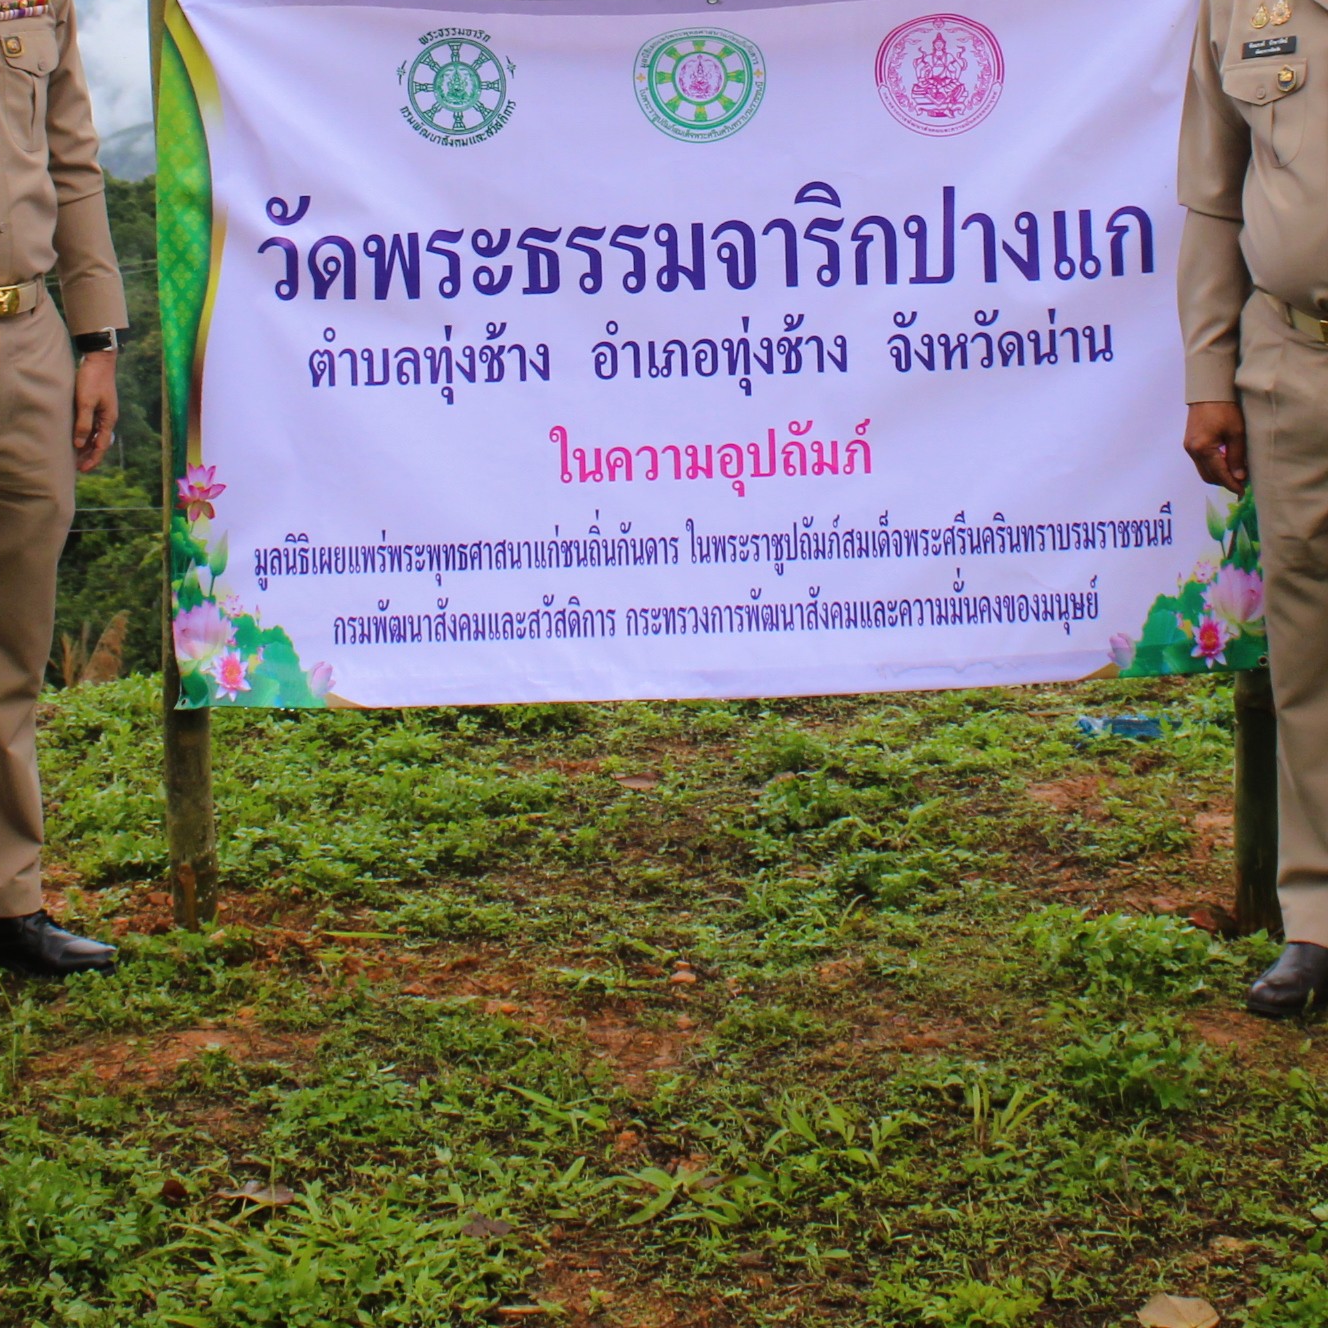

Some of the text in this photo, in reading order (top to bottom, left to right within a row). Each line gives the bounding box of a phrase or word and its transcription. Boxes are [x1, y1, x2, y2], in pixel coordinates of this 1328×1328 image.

[399, 99, 517, 148] กรมพัฒนาสังคมและสวัสดิการ
[256, 180, 1155, 302] วัดพระธรรมจาริกปางแก
[308, 307, 1114, 406] ตำบลทุ่งช้าง อำเภอทุ่งช้าง จังหวัดน่าน
[548, 417, 872, 498] ในความอุปถัมภ์
[254, 500, 1173, 592] มูลนิธิเผยแพร่พระพุทธศาสนาแก่ชนถิ่นกันดาร ในพระราชูปถัมภ์สมเด็จพระศรีนครินทราบรมราชชนนี
[333, 567, 1099, 646] กรมพัฒนาสังคมและสวัสดิการ กระทรวงการพัฒนาสังคมและความมั่นคงของมนุษย์
